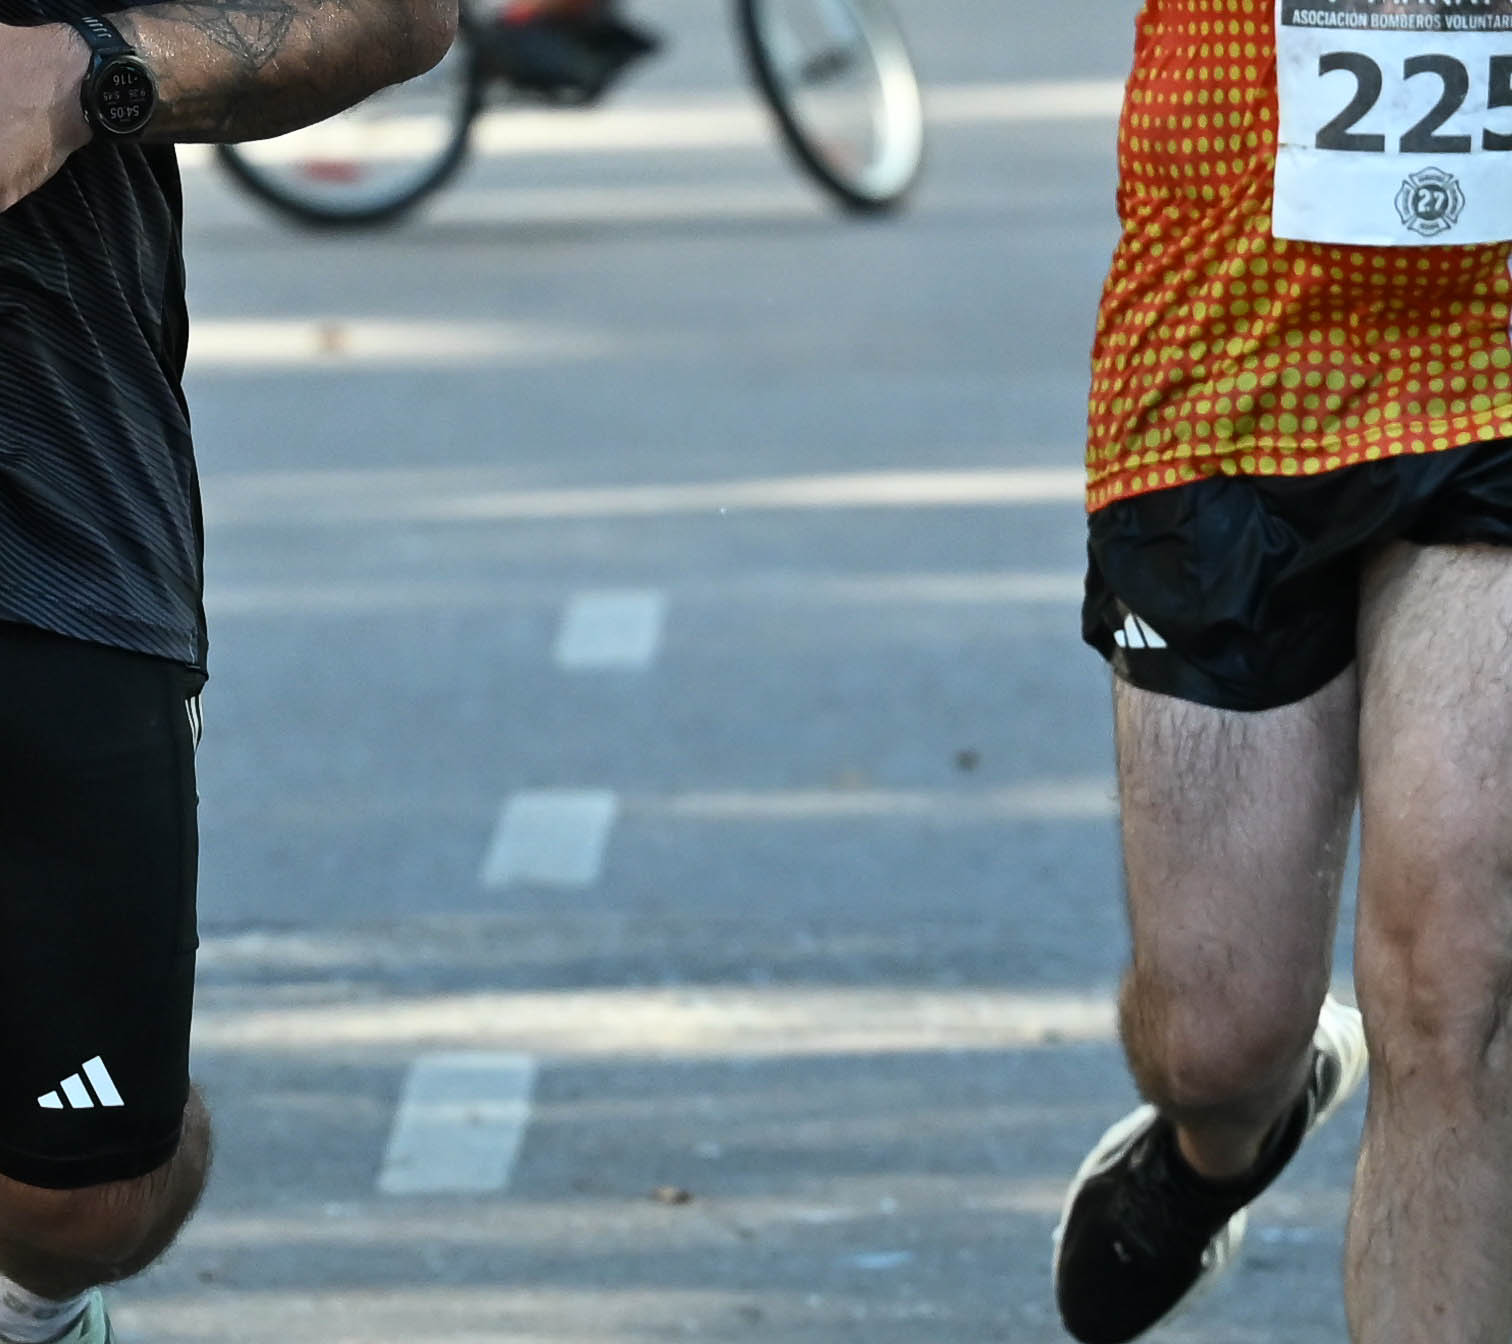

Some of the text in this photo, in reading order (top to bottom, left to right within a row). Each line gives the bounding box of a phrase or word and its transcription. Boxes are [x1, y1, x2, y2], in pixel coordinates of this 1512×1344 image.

[1292, 9, 1367, 28] ASOCIACIÓN
[1370, 12, 1442, 30] BOMBEROS
[1418, 188, 1445, 213] 27
